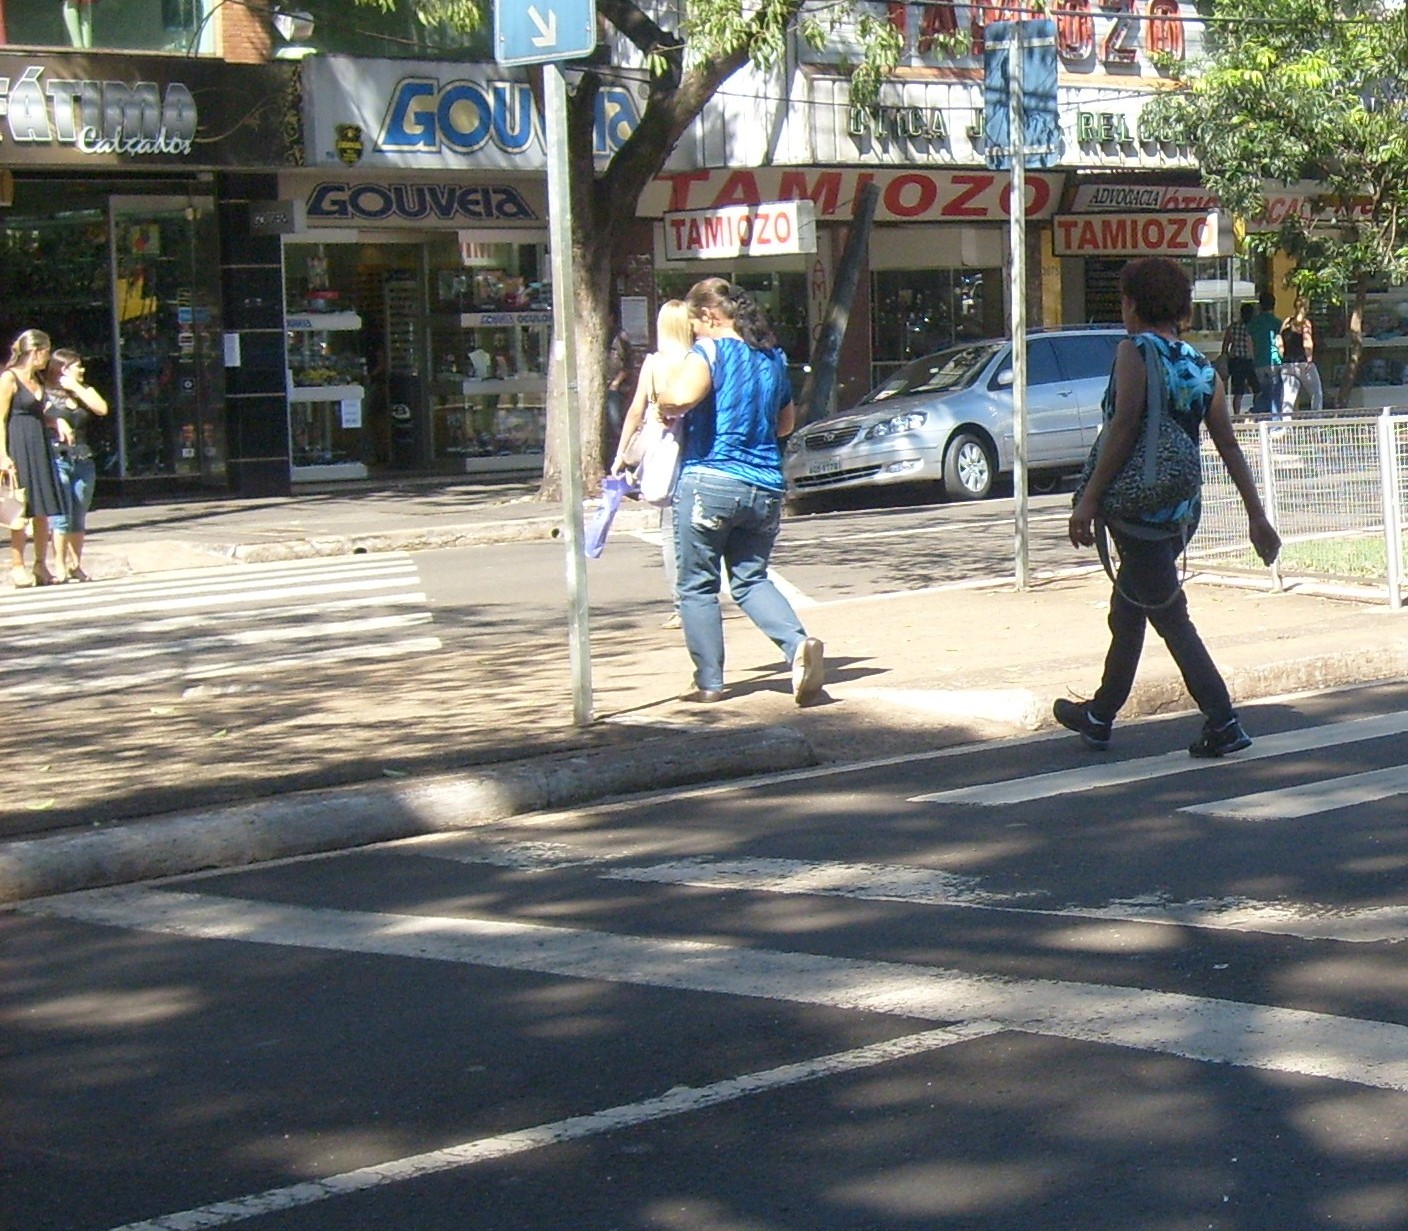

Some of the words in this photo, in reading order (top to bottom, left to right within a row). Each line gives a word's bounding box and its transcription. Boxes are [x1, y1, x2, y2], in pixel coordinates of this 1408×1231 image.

[886, 0, 1187, 63] TAMOZO
[372, 77, 643, 155] GOUIA
[79, 126, 192, 156] Calçados
[306, 182, 539, 220] GOUVEIA
[655, 169, 1051, 217] TAMIOZO
[1089, 187, 1160, 207] ADVOCACIA
[671, 210, 791, 251] TAMIOZO
[1058, 217, 1213, 250] TAMIOZO
